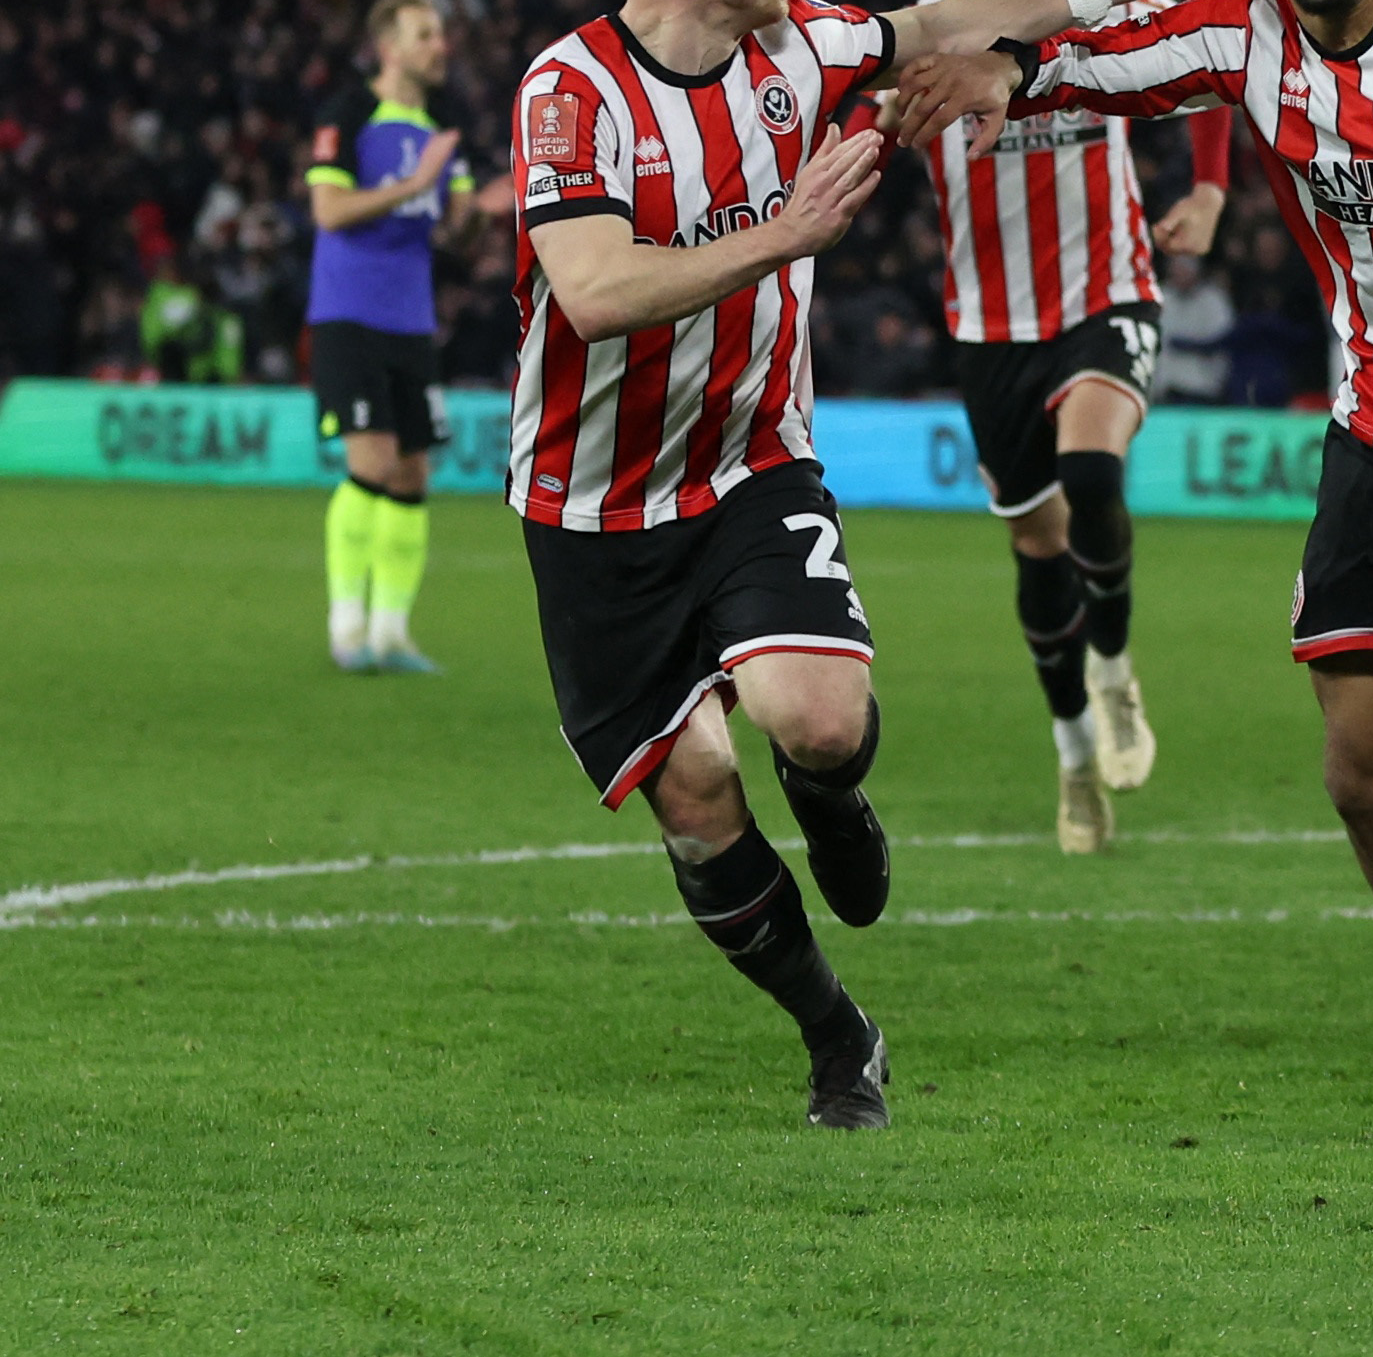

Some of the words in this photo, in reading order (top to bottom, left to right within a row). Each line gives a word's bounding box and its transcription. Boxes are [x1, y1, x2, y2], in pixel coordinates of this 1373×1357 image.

[1280, 91, 1307, 111] errea
[532, 136, 569, 145] Emirates
[532, 146, 543, 156] FA
[543, 145, 570, 155] CUP
[636, 160, 671, 177] errea
[529, 172, 594, 195] TOGETHER
[97, 401, 273, 468] DREAM
[1185, 430, 1325, 499] LEAG
